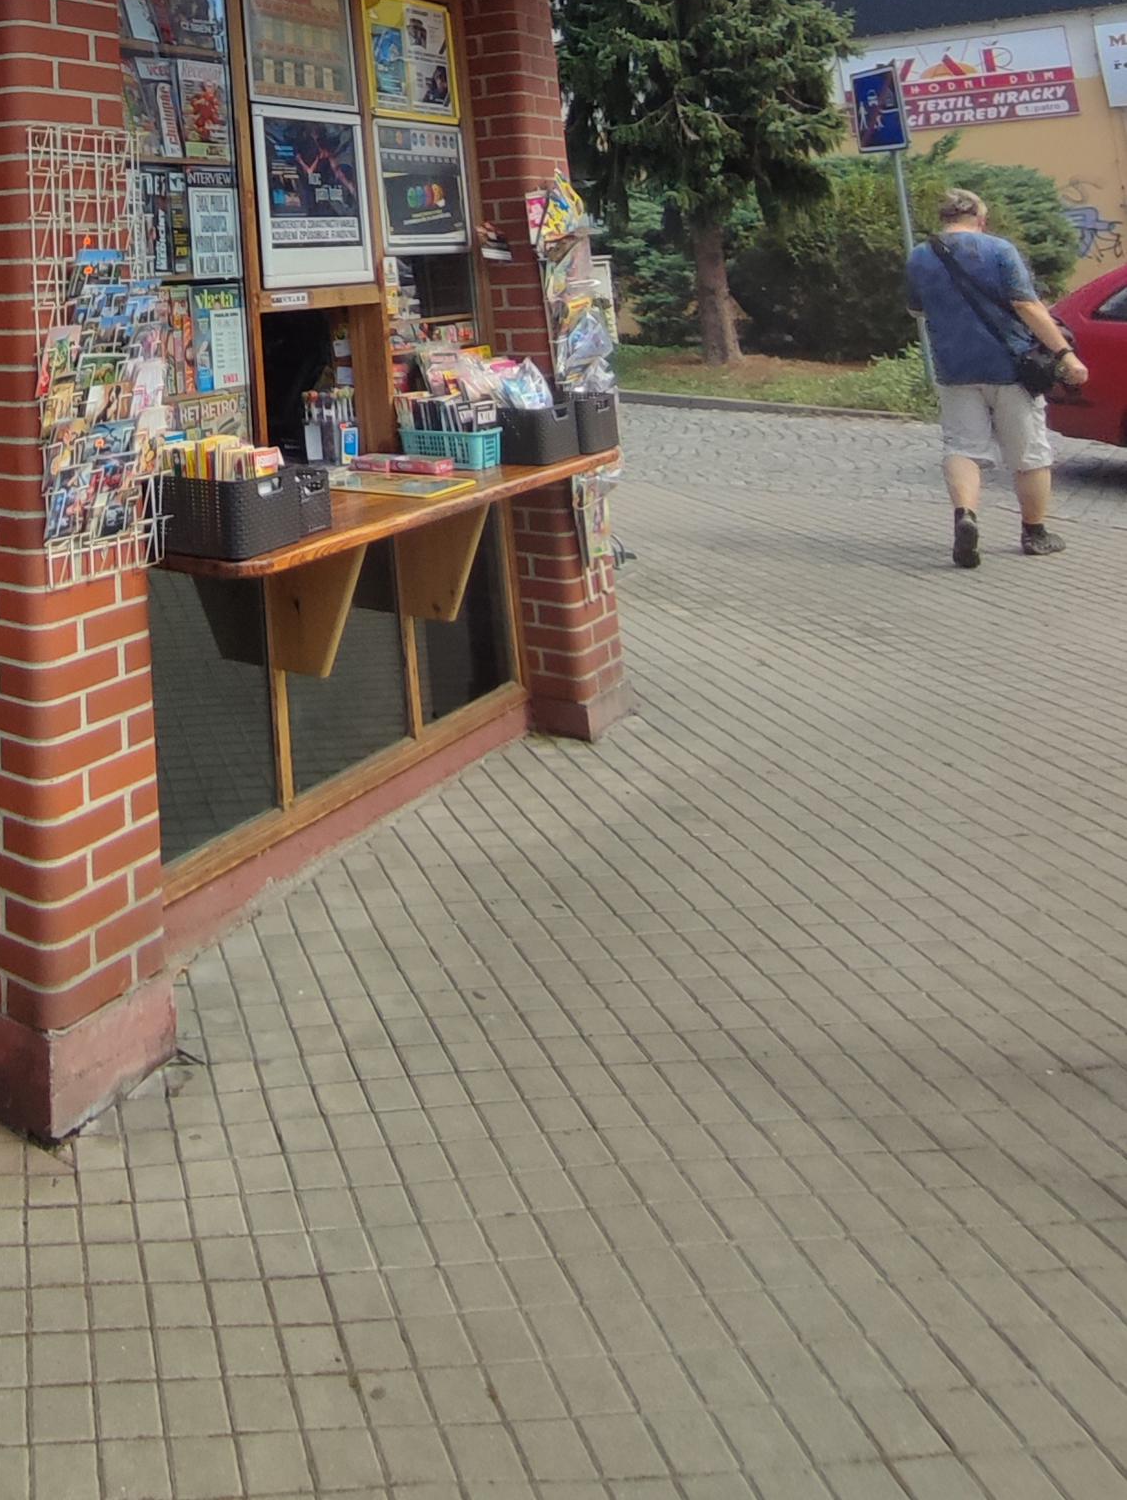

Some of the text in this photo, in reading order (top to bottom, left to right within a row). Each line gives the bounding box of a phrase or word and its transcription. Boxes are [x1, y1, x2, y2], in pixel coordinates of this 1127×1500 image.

[910, 77, 986, 94] HODNÍ
[917, 96, 973, 112] TEXTIL
[202, 398, 237, 418] RETRO
